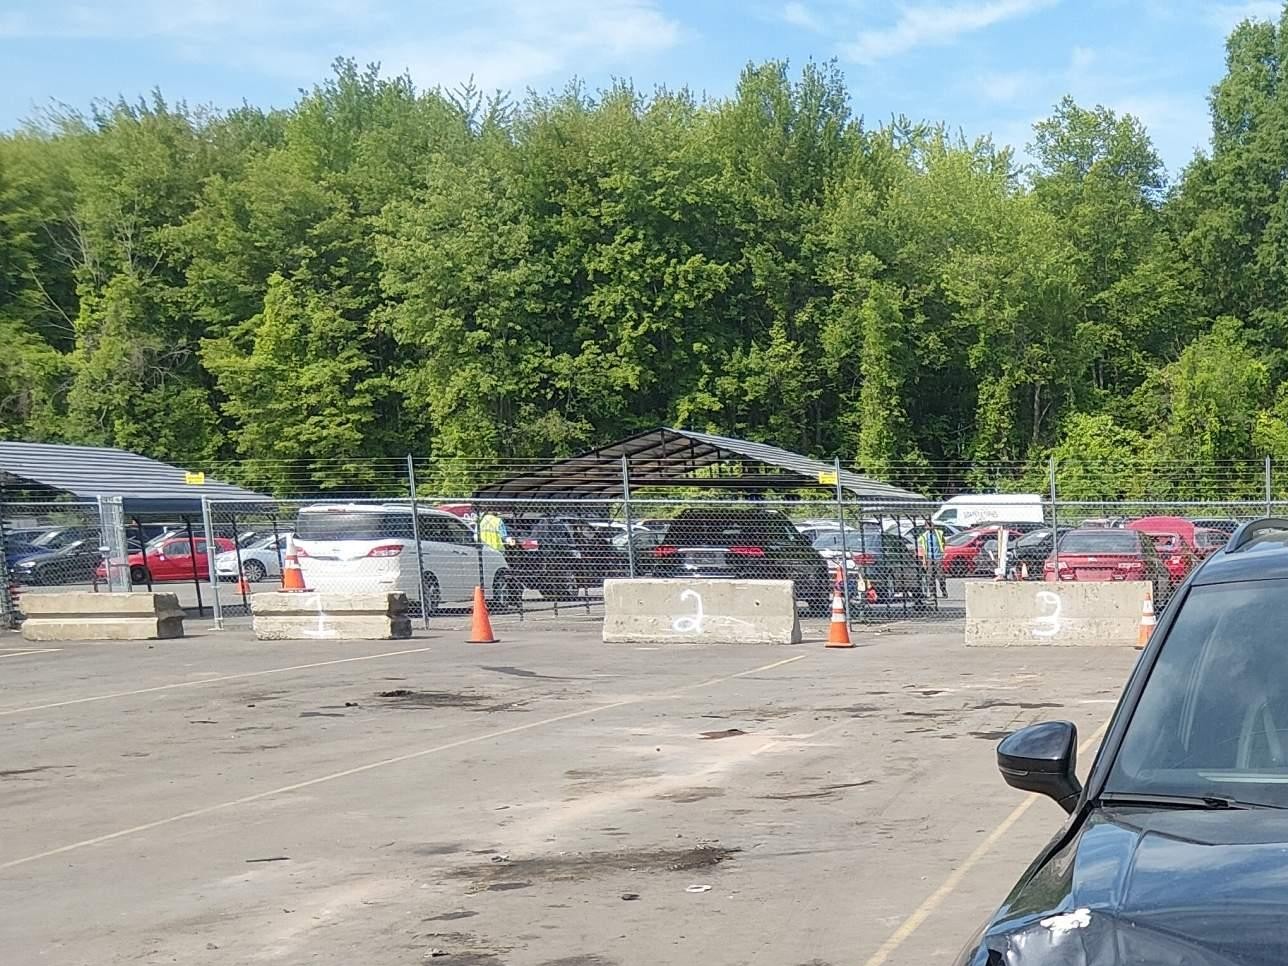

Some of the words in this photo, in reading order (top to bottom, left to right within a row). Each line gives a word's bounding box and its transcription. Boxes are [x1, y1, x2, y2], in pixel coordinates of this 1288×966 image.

[304, 592, 337, 639] 1
[672, 588, 704, 633] 2
[1031, 590, 1062, 636] 3
